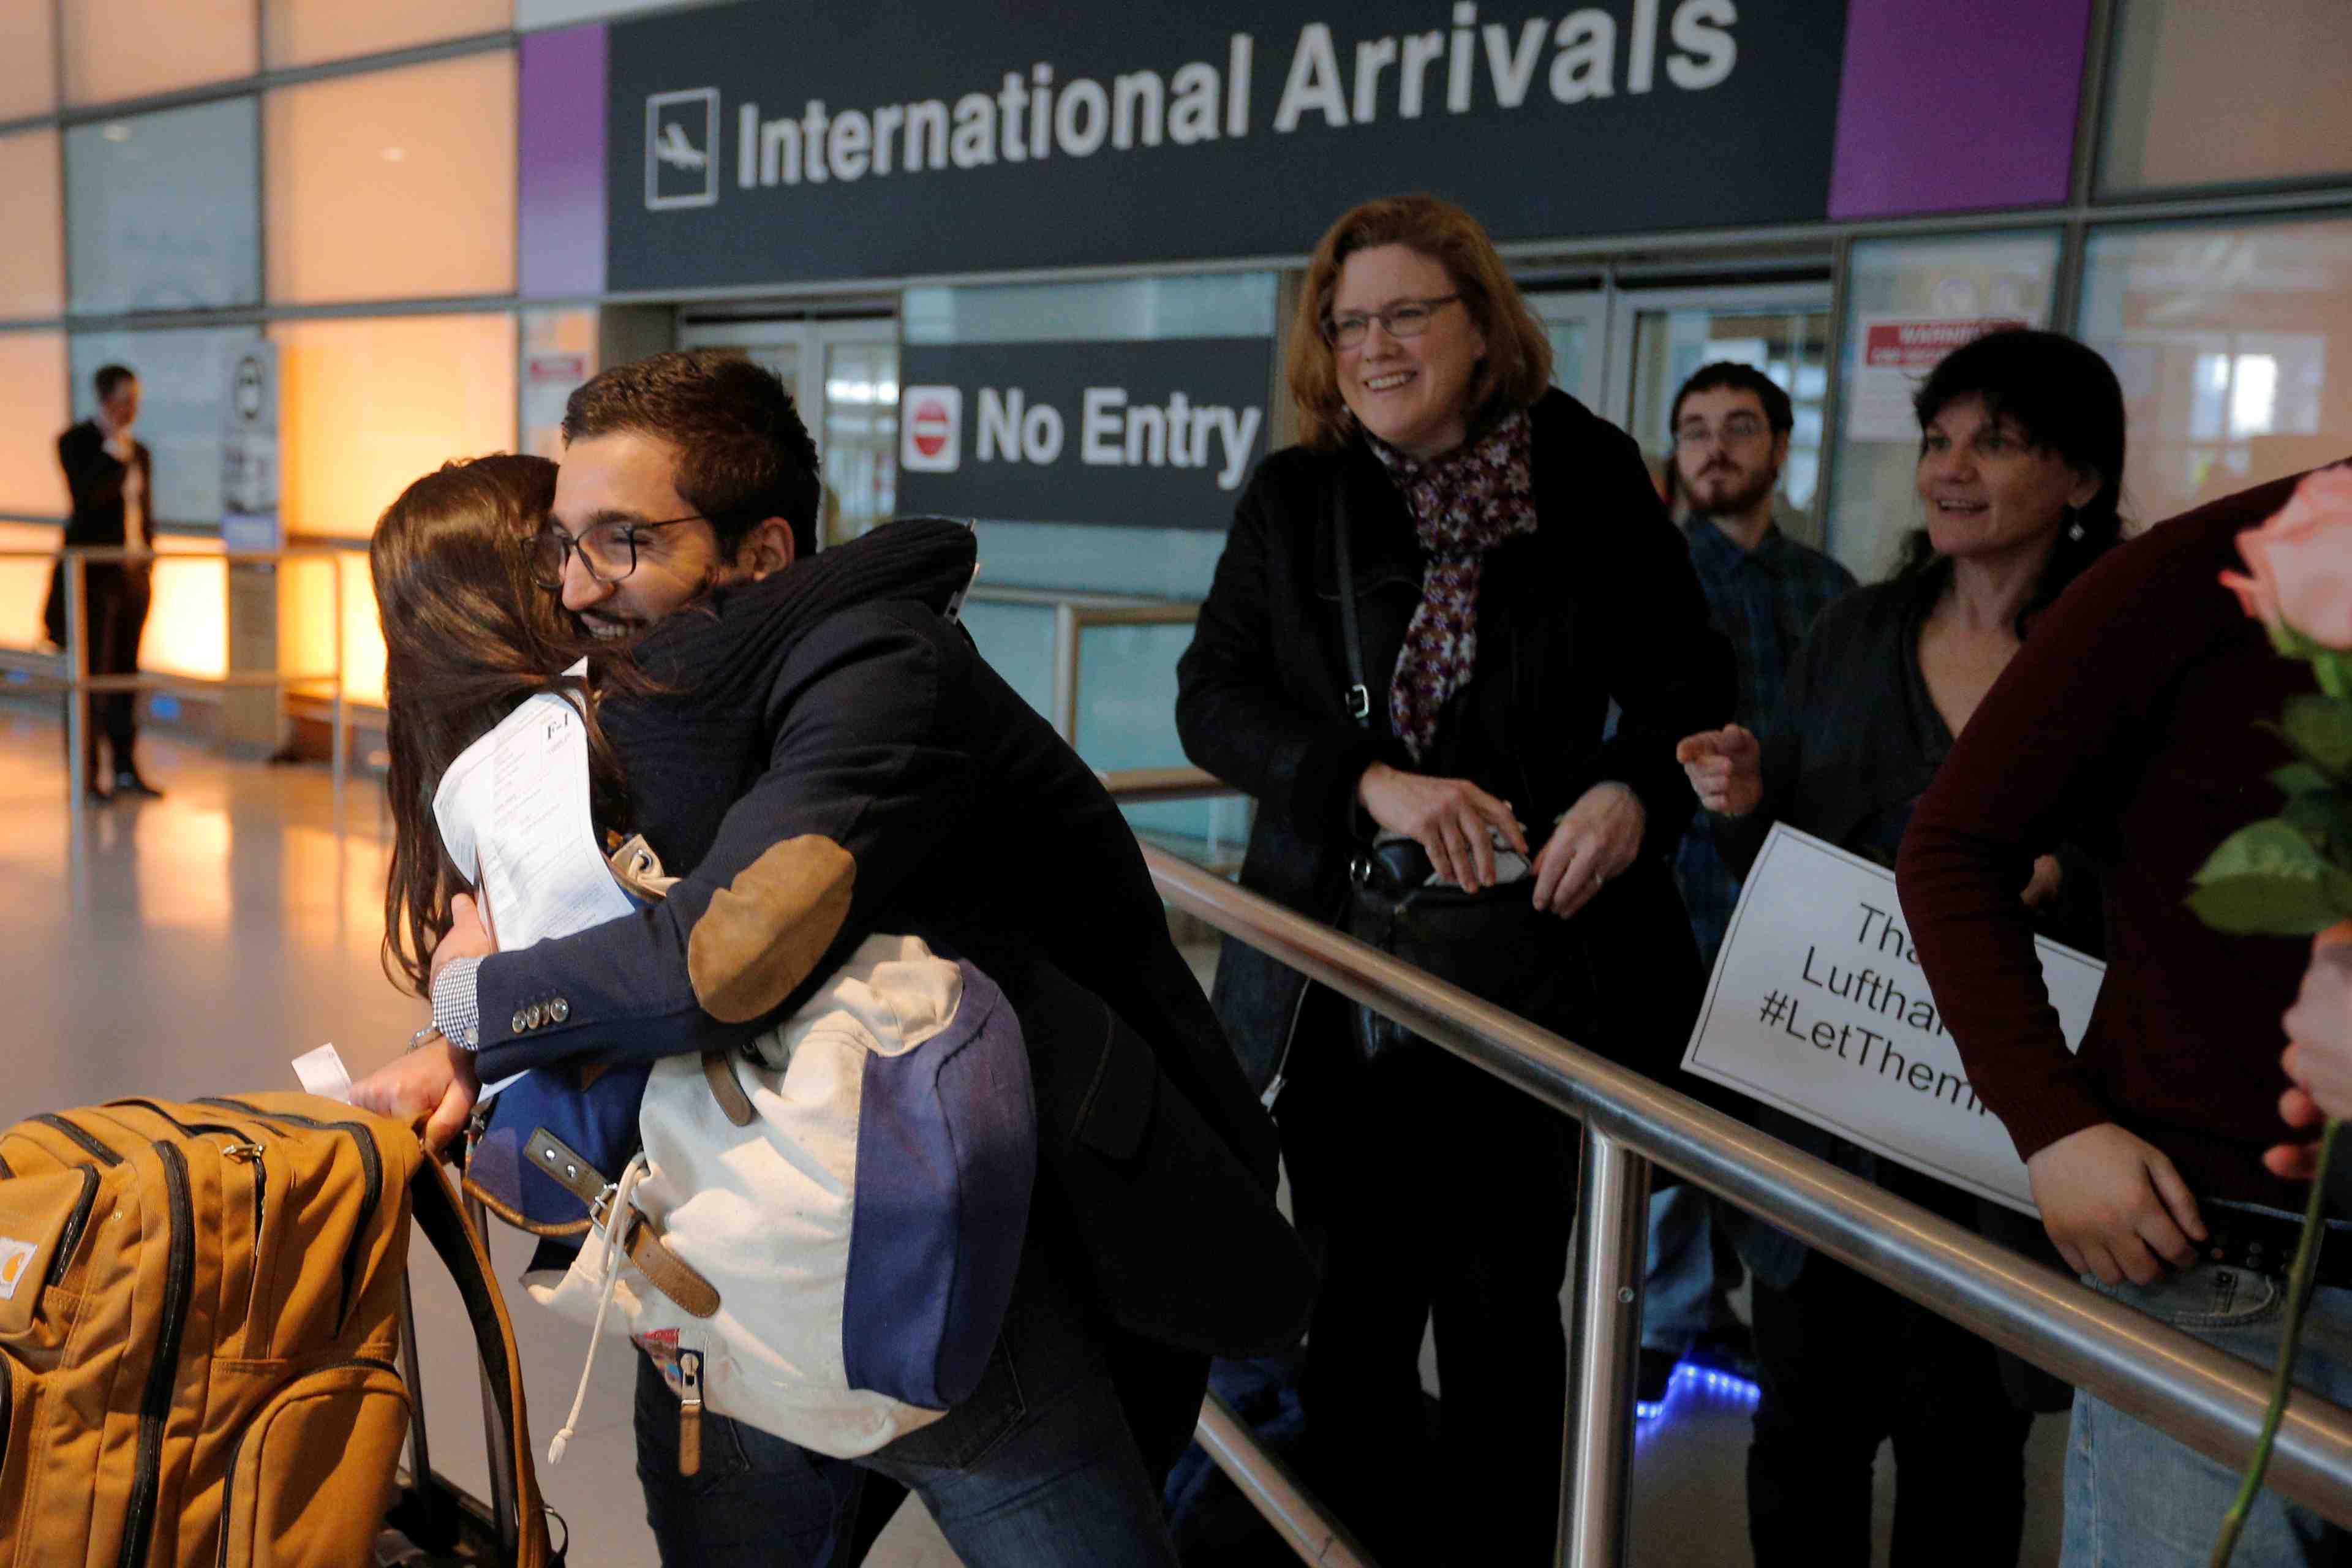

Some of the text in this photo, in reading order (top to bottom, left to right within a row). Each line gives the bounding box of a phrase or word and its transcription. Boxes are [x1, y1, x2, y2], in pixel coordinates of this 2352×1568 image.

[739, 0, 1738, 188] International Arrivals
[976, 386, 1262, 490] No Entry
[1801, 946, 1945, 1036] Luftha
[1759, 990, 1987, 1116] #LetThem
